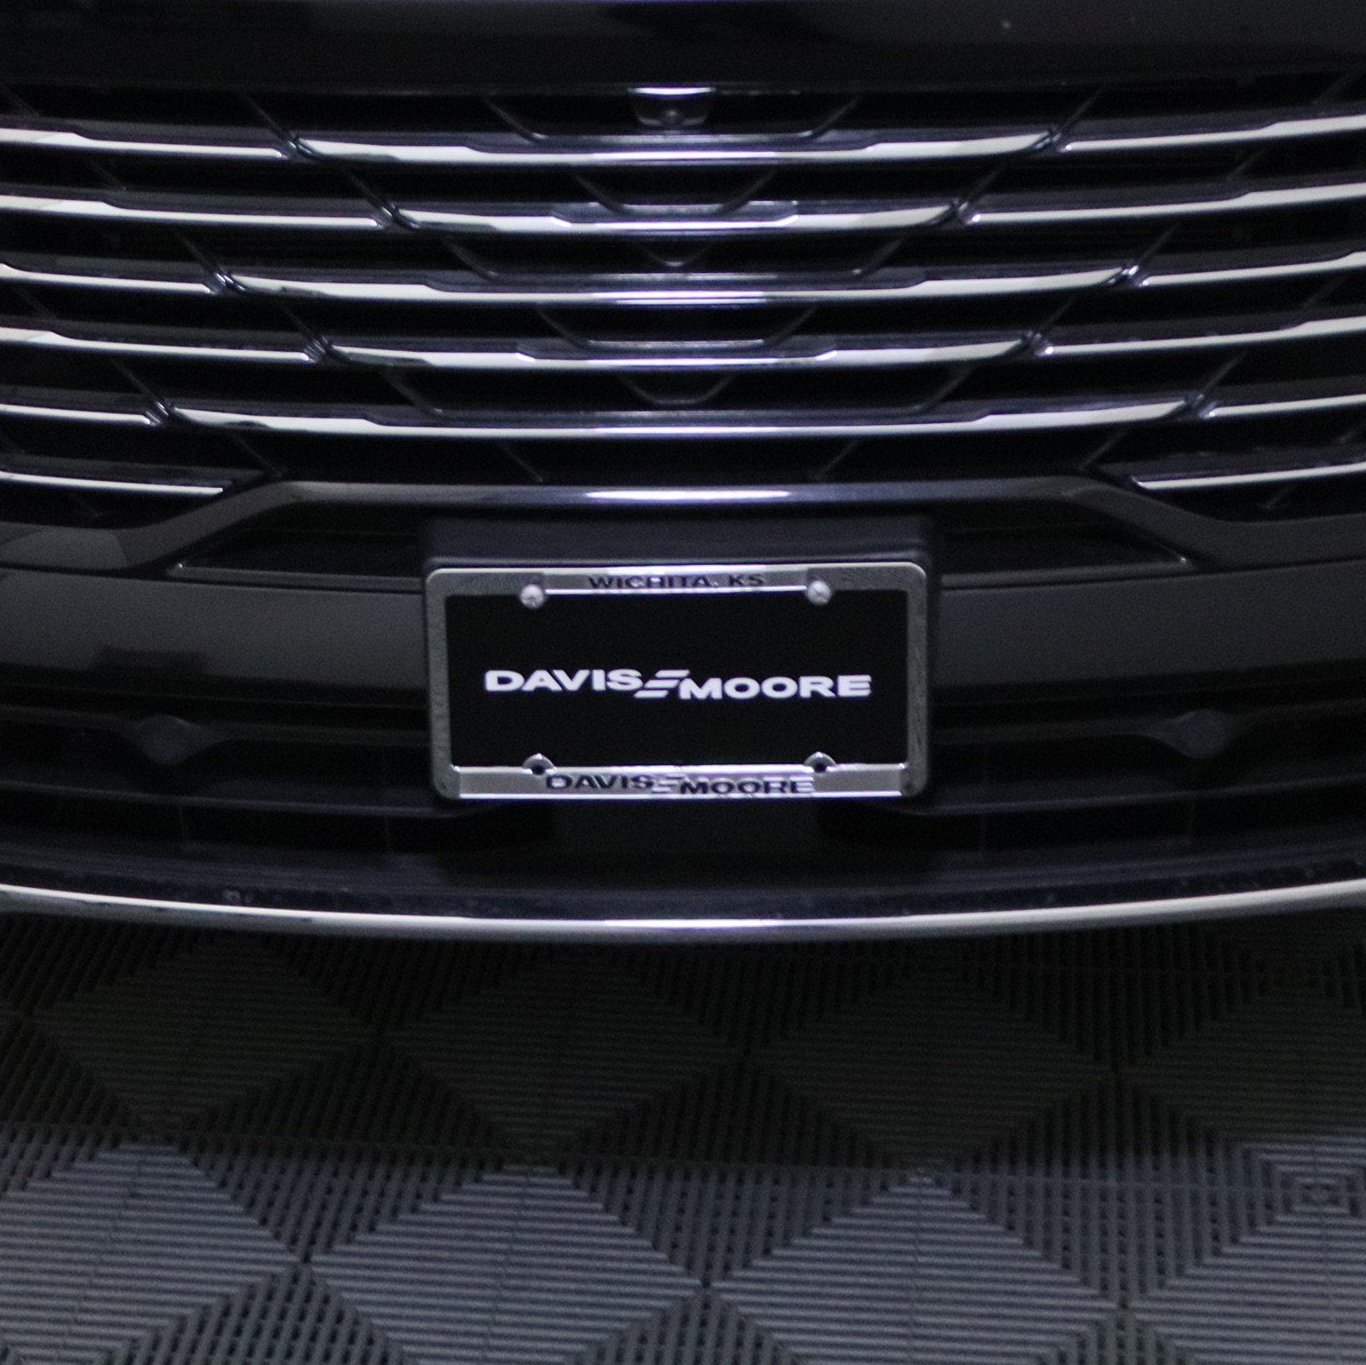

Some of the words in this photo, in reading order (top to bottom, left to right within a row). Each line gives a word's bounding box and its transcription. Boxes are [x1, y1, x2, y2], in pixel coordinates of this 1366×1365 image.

[728, 573, 765, 587] KS
[484, 669, 643, 692] DAVIS
[678, 674, 873, 700] MOORE
[545, 774, 655, 790] DAVIS
[680, 775, 815, 795] MOORE
